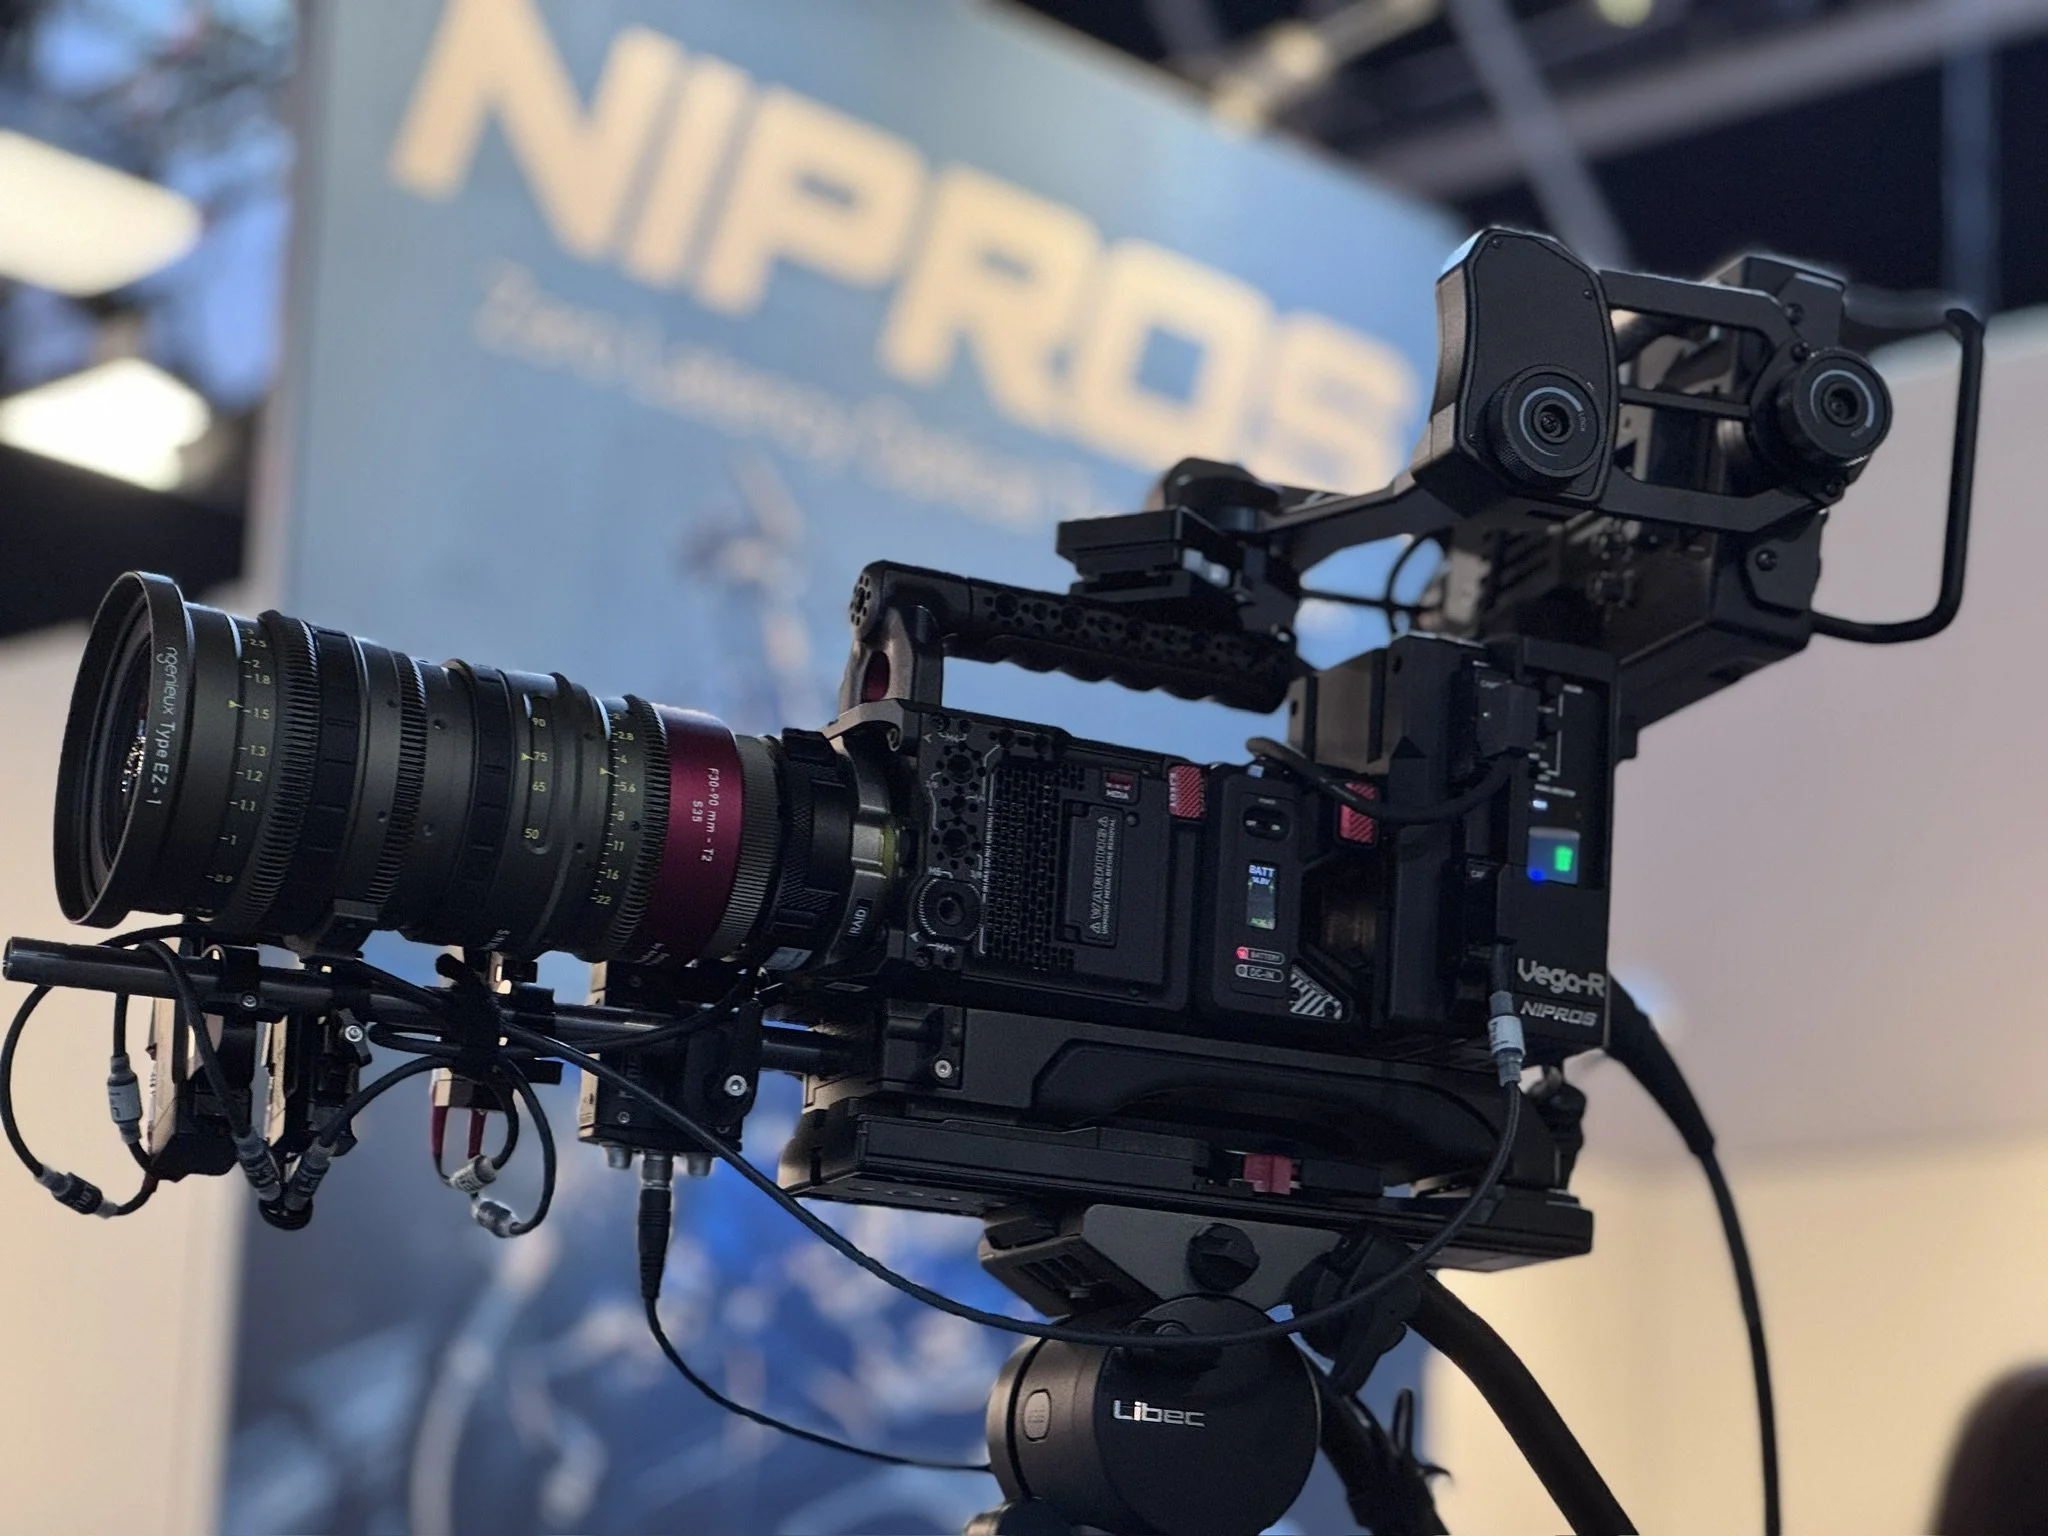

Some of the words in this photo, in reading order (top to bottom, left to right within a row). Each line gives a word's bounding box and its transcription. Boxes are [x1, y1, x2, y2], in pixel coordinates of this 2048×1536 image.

[390, 0, 1425, 495] NIPROS
[252, 659, 261, 669] 2
[253, 707, 271, 720] 1.5
[532, 717, 547, 728] 90
[155, 721, 176, 758] Type
[250, 744, 267, 757] 1.3
[533, 751, 548, 762] 75
[246, 769, 264, 782] 1.2
[532, 781, 546, 792] 65
[619, 781, 637, 793] 5.6
[240, 799, 257, 812] 1.1
[691, 799, 704, 823] S35
[616, 810, 625, 821] 8
[706, 810, 717, 833] mm
[524, 828, 540, 839] 50
[612, 840, 625, 852] 11
[701, 848, 715, 862] T2
[605, 868, 619, 880] 16
[1249, 864, 1275, 878] BATT
[1520, 1000, 1598, 1028] NIPROS
[1113, 1399, 1207, 1428] Libec
